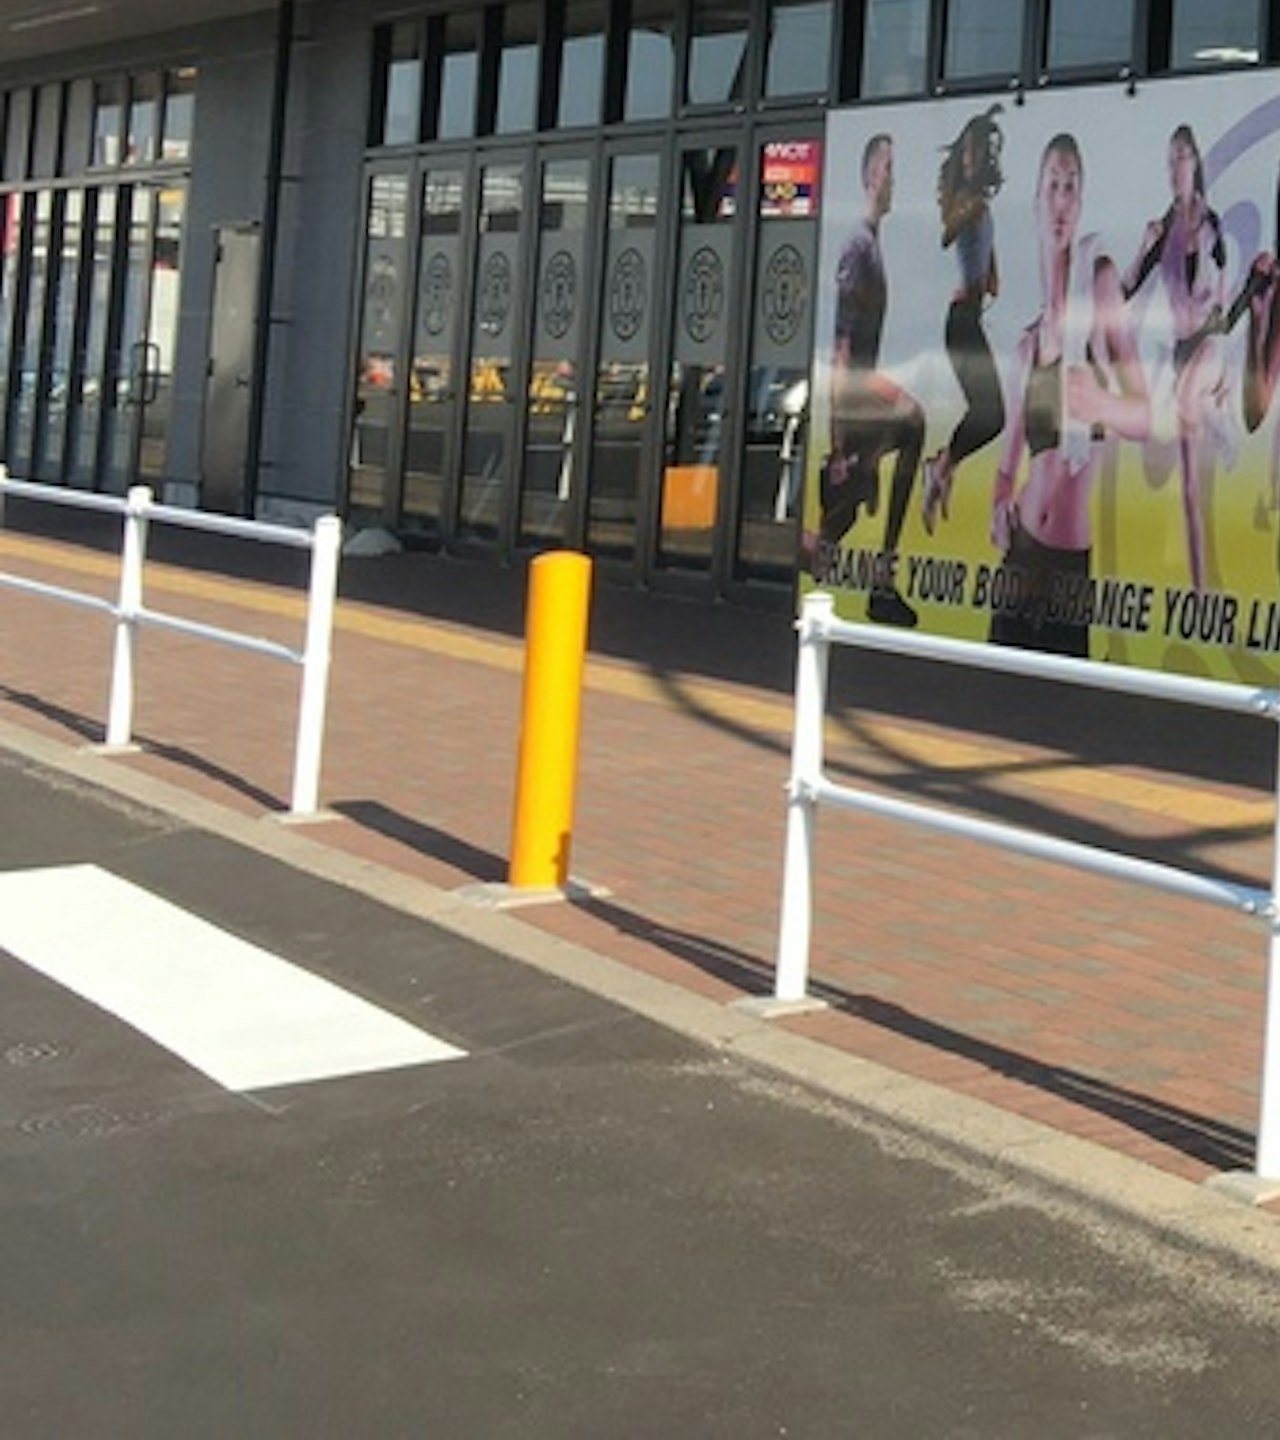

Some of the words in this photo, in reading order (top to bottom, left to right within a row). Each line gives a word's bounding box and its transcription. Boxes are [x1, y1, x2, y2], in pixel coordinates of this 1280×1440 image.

[907, 555, 968, 605] YOUR
[1047, 574, 1155, 633] CHANGE
[1163, 587, 1239, 644] YOUR
